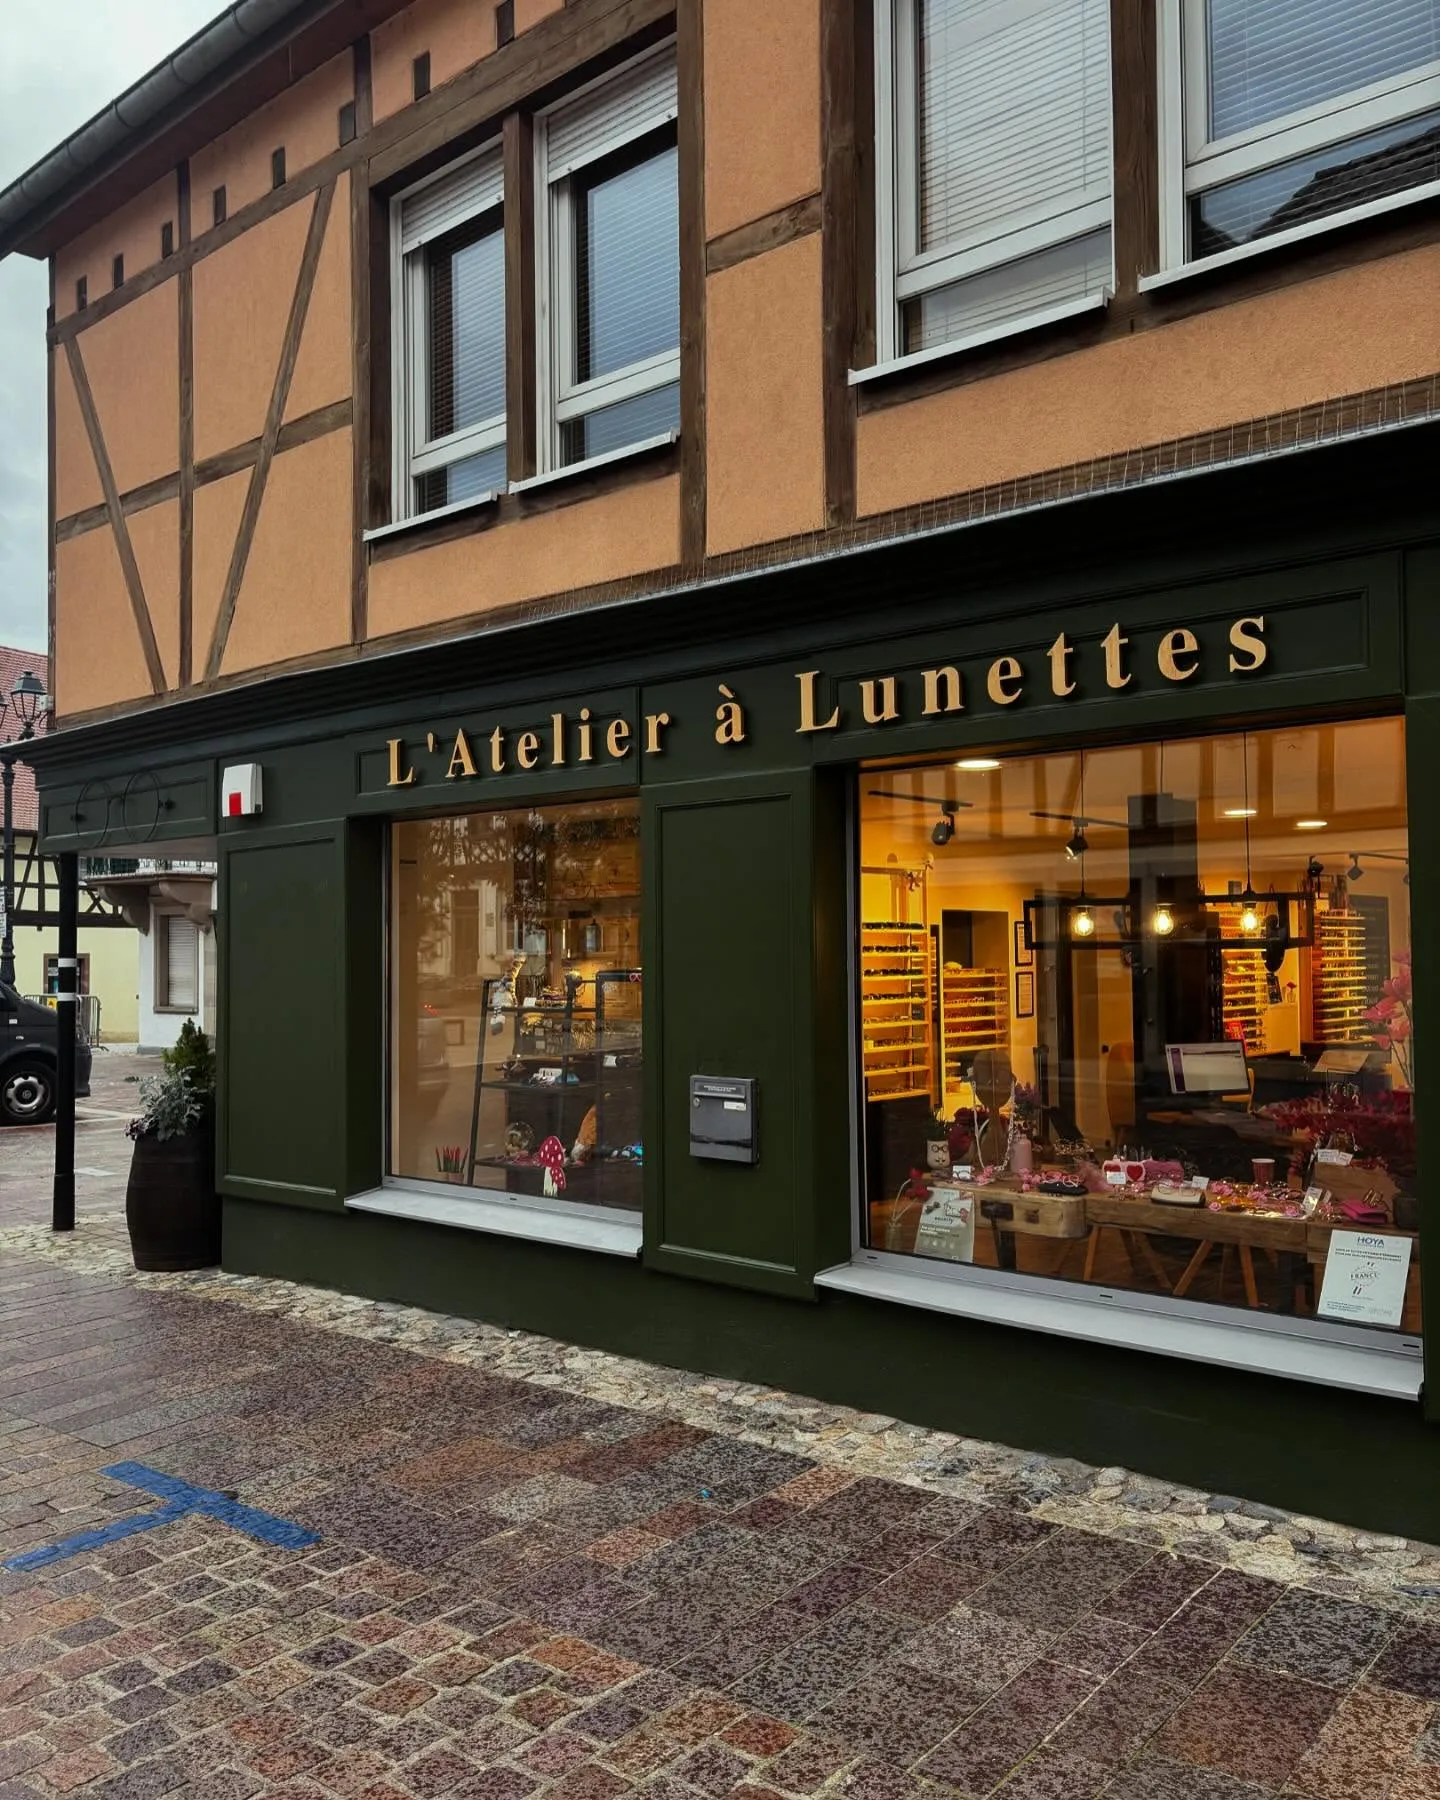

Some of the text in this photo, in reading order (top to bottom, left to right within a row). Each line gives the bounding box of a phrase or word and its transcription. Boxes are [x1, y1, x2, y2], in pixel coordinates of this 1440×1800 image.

[386, 616, 1267, 787] L'Atelier à Lunettes
[1357, 1236, 1385, 1246] HOYA
